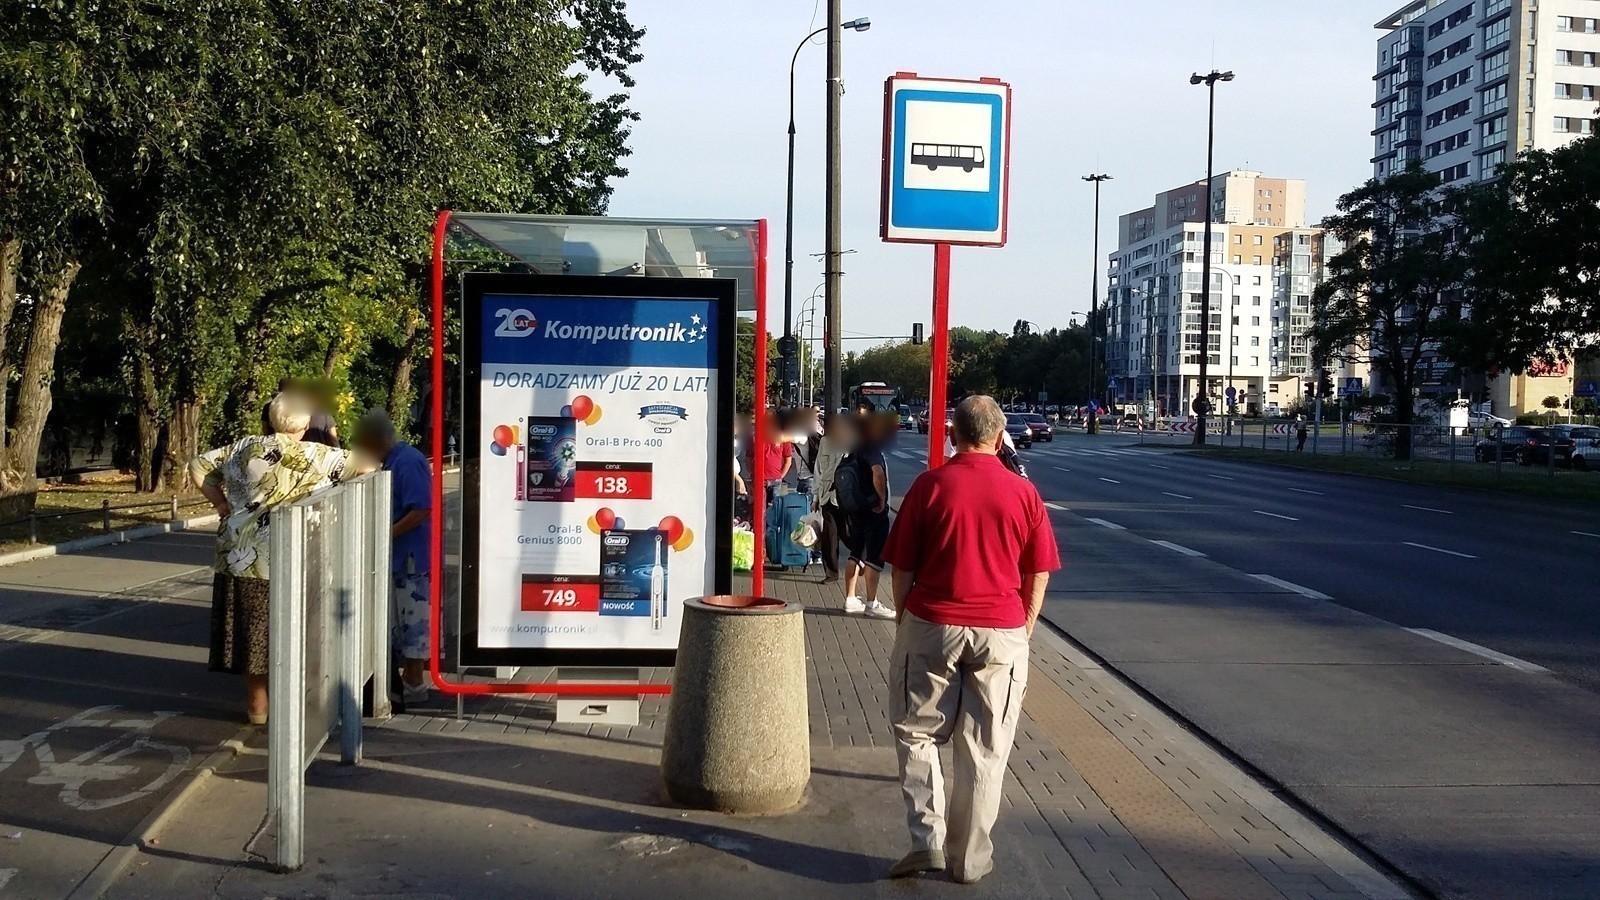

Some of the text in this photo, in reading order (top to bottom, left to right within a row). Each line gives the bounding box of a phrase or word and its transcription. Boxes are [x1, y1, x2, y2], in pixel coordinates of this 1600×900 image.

[494, 308, 537, 338] 20
[514, 319, 530, 328] LAT
[544, 320, 686, 344] Komputronik
[493, 371, 709, 394] DORADZAMY JUŻ 20 LAT!
[586, 437, 663, 448] Oral-B Pro 400
[548, 524, 582, 534] Oral-B
[517, 535, 582, 545] Genius 8000
[603, 602, 635, 611] NOWOŚĆ
